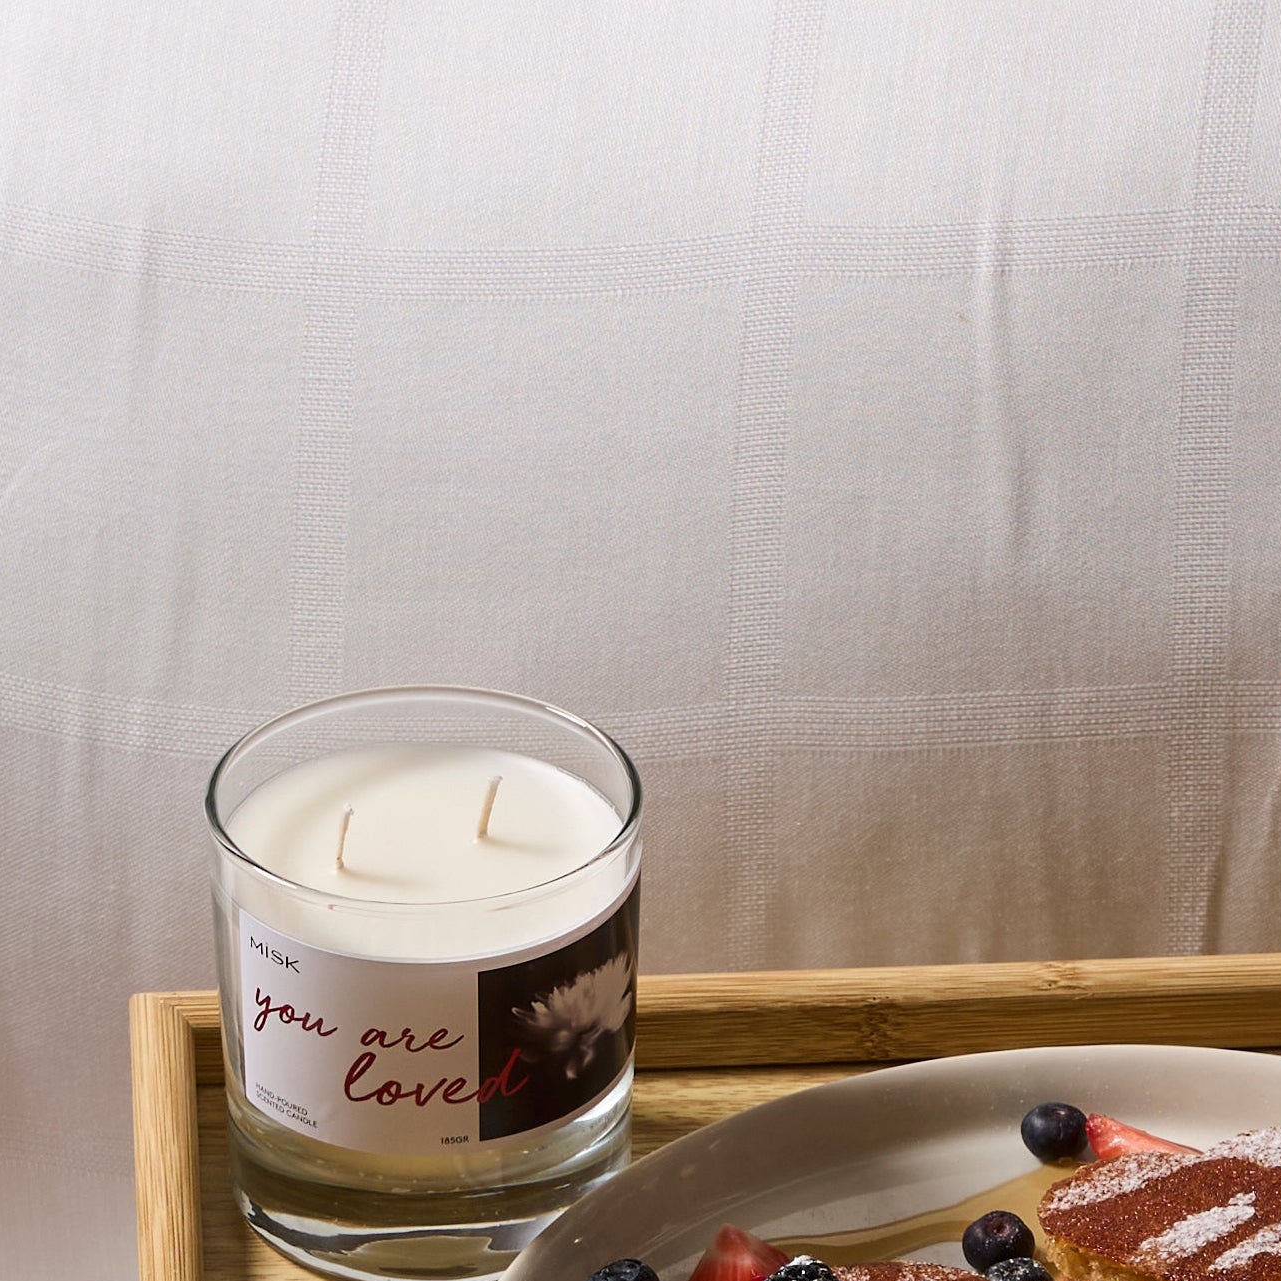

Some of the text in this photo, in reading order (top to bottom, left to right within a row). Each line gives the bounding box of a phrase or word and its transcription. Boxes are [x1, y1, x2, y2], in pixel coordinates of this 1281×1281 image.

[254, 987, 465, 1053] you are
[343, 1047, 530, 1107] loved
[255, 1090, 318, 1128] SCENTED CANDLE
